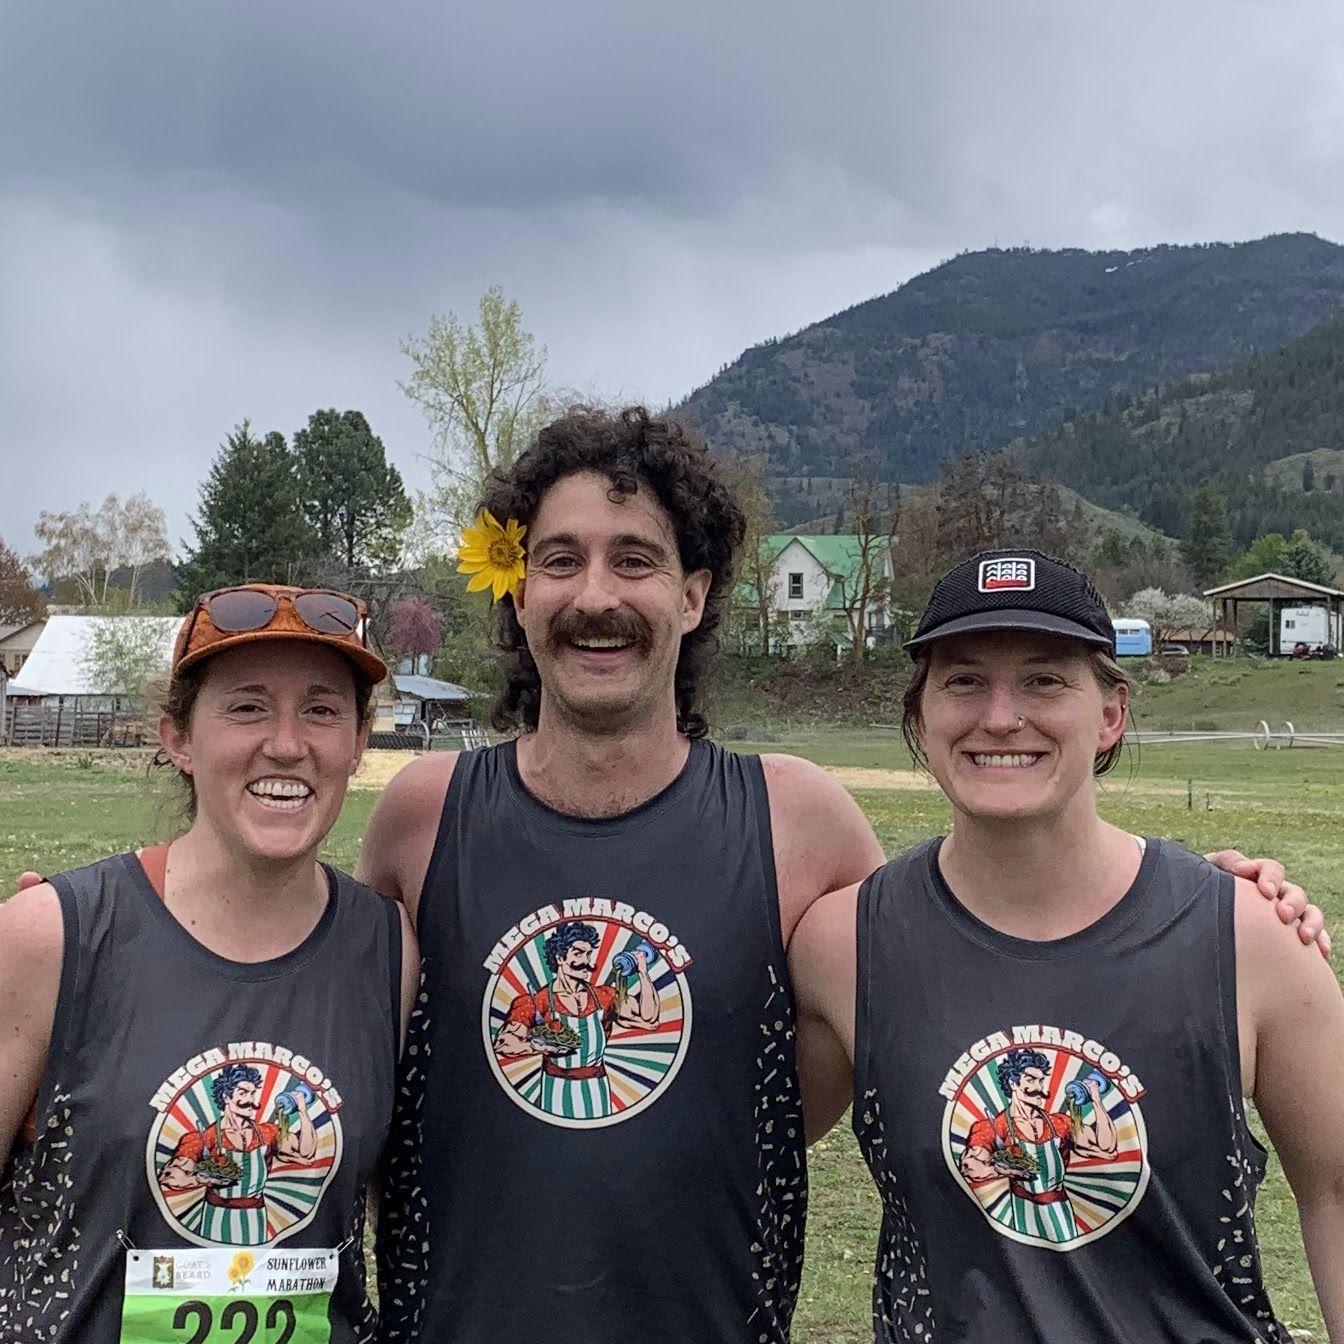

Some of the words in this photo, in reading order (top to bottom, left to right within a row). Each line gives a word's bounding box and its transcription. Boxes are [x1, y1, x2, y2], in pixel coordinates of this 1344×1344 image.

[483, 904, 561, 975] MEGA
[562, 897, 693, 972] MARCO'S
[149, 1047, 226, 1113] MEGA
[227, 1041, 345, 1113] MARCO'S
[938, 1030, 1012, 1101] MEGA
[1011, 1024, 1148, 1102] MARCO'S
[267, 1257, 326, 1271] SUNFLOWER
[267, 1278, 326, 1291] MARATHON
